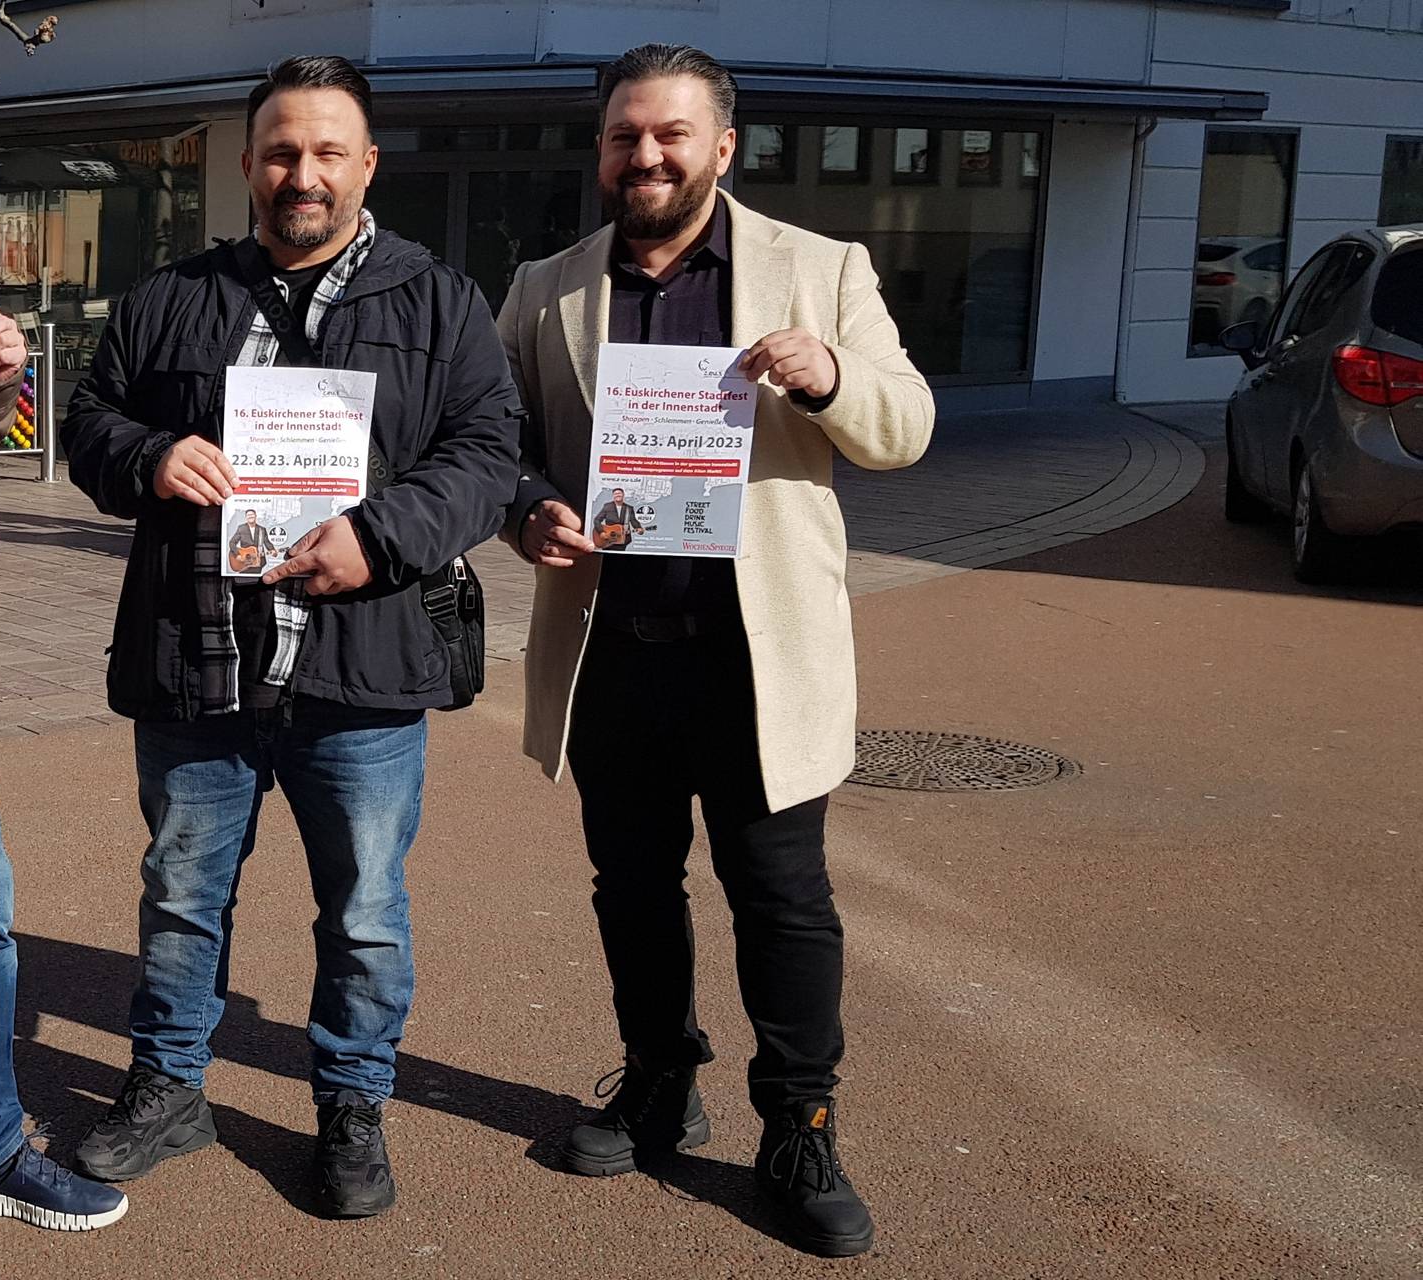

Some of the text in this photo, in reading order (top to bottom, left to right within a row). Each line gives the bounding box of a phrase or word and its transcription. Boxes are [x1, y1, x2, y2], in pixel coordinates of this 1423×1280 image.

[606, 386, 748, 401] 16. Euskirchener Stadtfest
[628, 400, 723, 413] in der Innenstadt
[233, 408, 364, 421] 16. Euskirchener Stadtfest
[255, 421, 342, 431] in der Innenstadt
[601, 433, 744, 450] 22. & 23. April 2023
[232, 454, 360, 469] 22. & 23. April 2023
